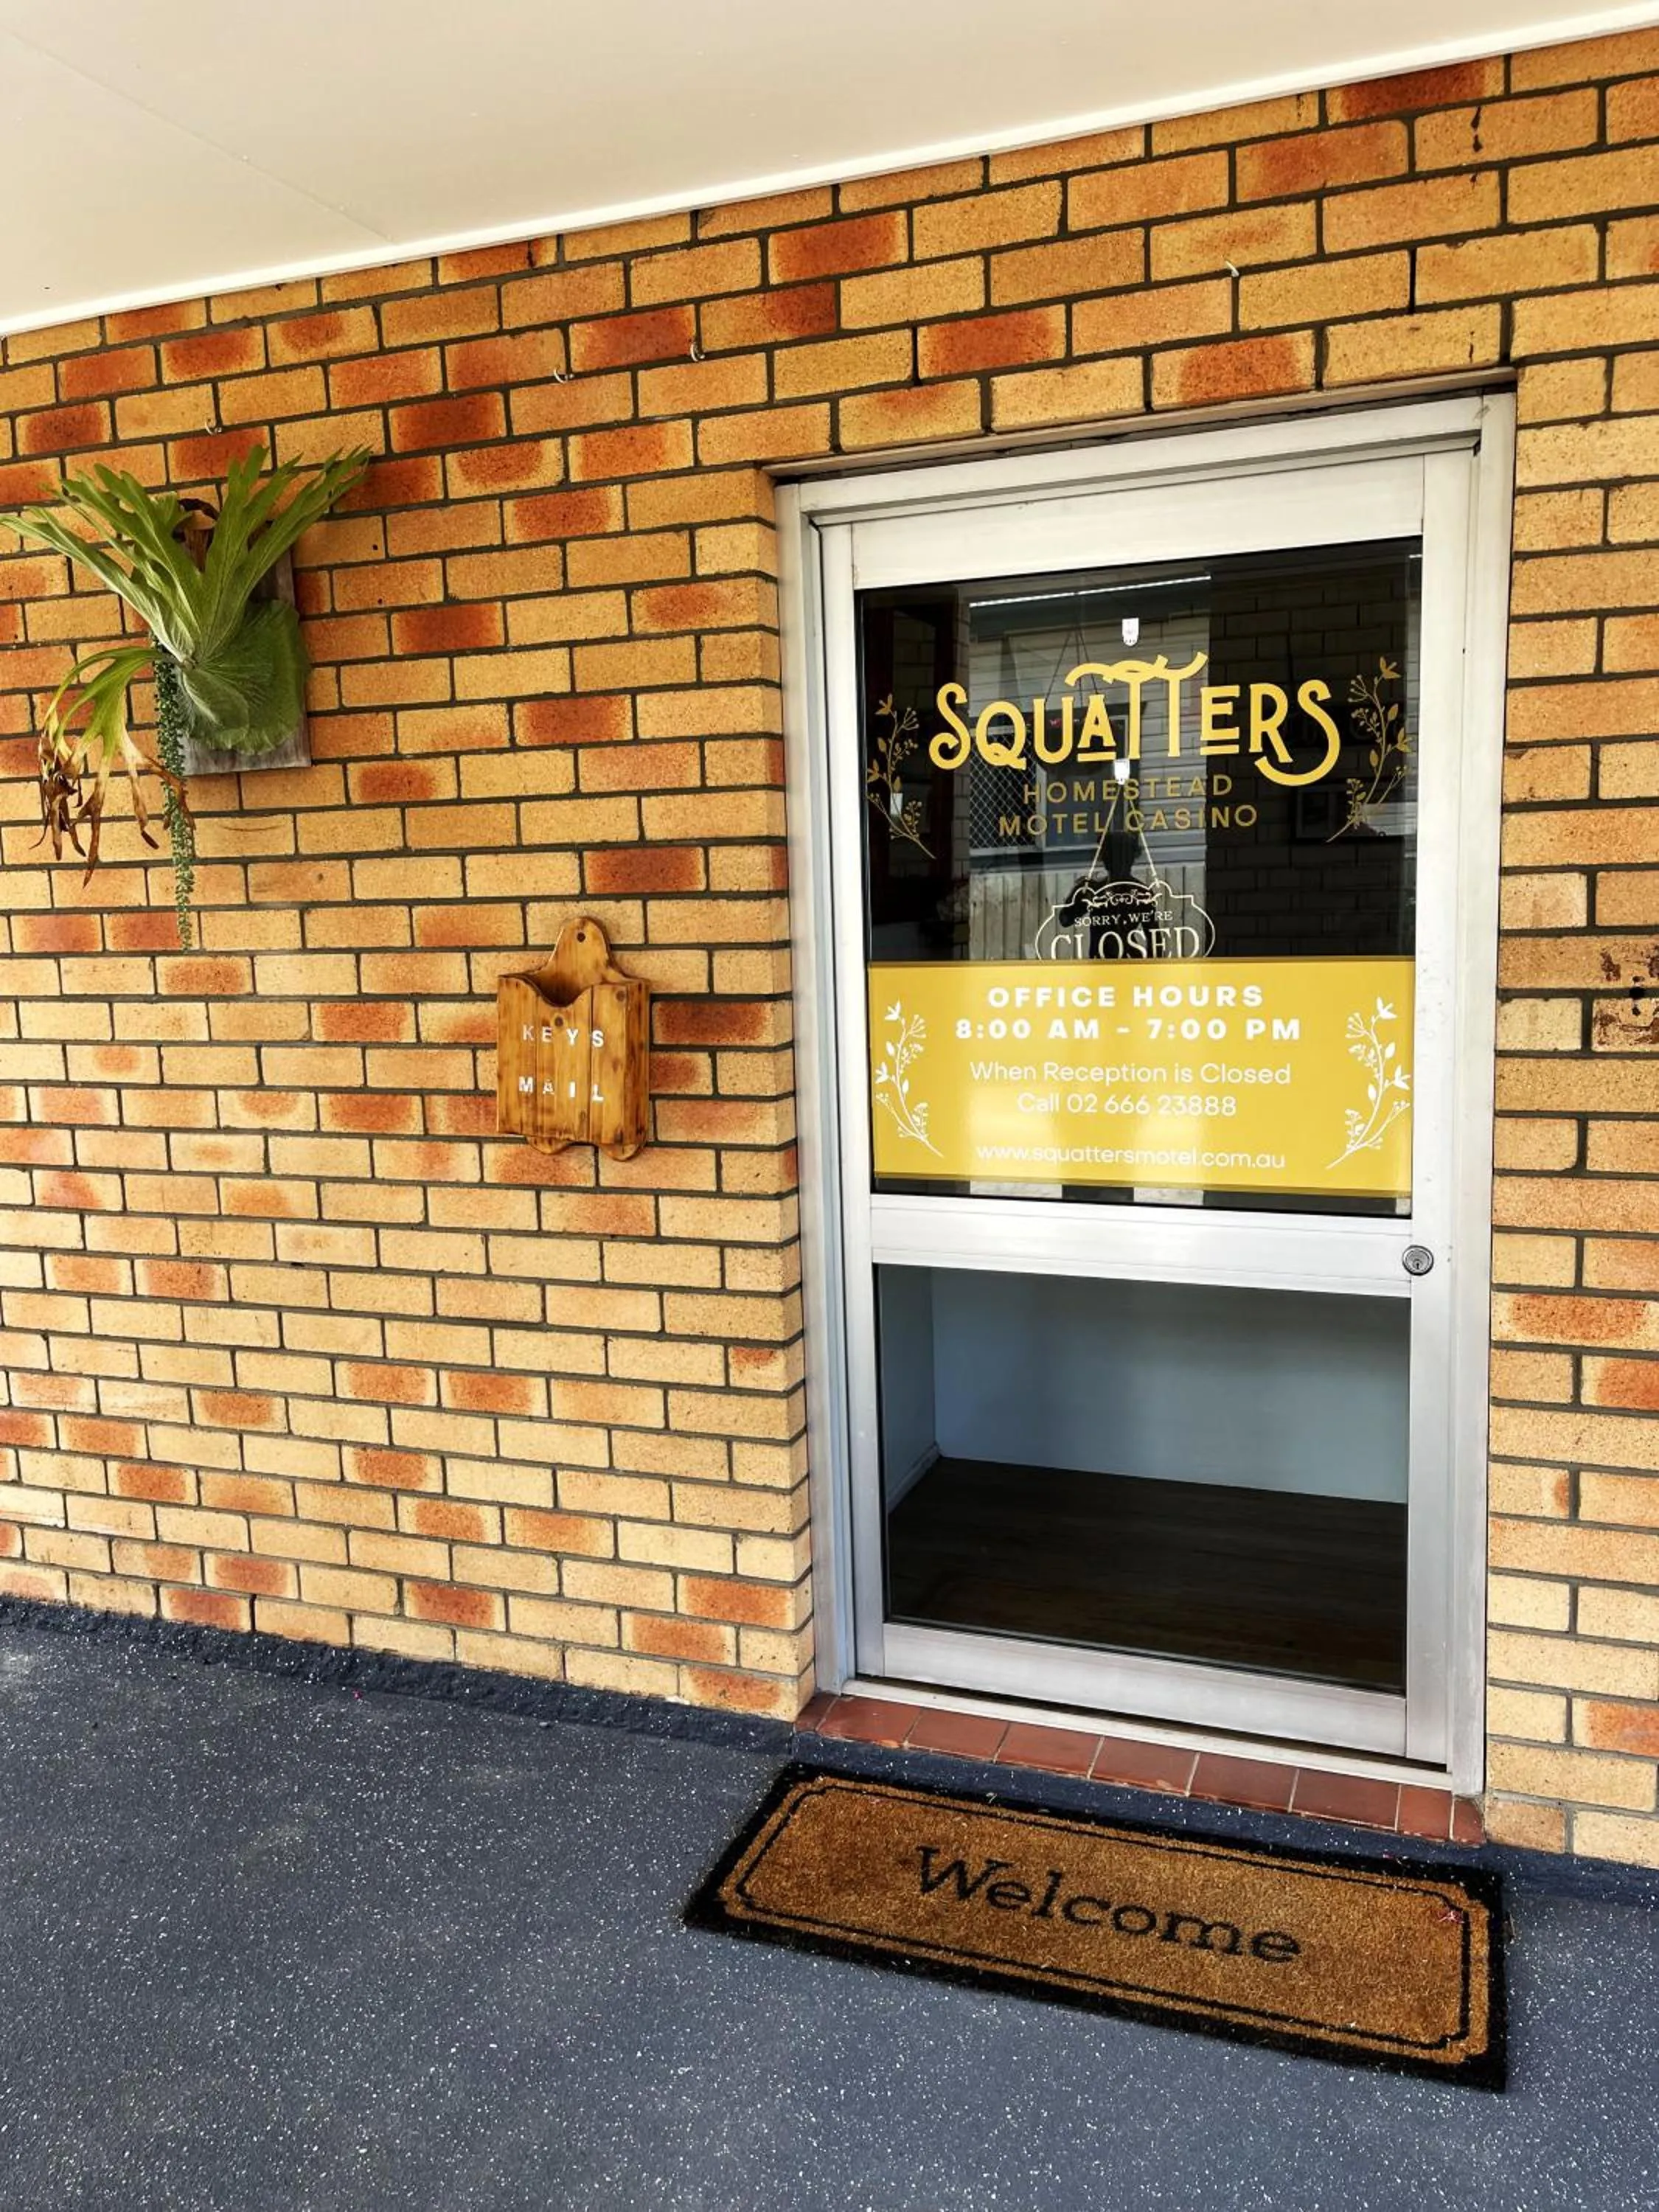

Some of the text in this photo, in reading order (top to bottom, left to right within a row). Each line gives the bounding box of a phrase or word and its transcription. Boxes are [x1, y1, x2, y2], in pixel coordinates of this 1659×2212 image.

[929, 652, 1340, 786] SQUATTERS
[1023, 775, 1233, 804] HOMESTEAD
[998, 804, 1258, 836] MOTEL CASINO
[1130, 910, 1173, 922] WE'RE
[1050, 926, 1200, 959] CLOSED
[988, 984, 1264, 1009] OFFICE HOURS
[522, 1024, 604, 1048] KEYS
[955, 1018, 1032, 1040] 8:00
[1047, 1018, 1099, 1040] AM
[1147, 1018, 1227, 1040] 7:00
[1245, 1018, 1300, 1040] PM
[970, 1060, 1291, 1087] When Reception is Closed
[518, 1076, 604, 1102] MAIL
[1017, 1092, 1237, 1117] Call 02 666 23888
[975, 1144, 1286, 1169] www.squattersmotel.com.au
[913, 1844, 1302, 1964] Welcome
